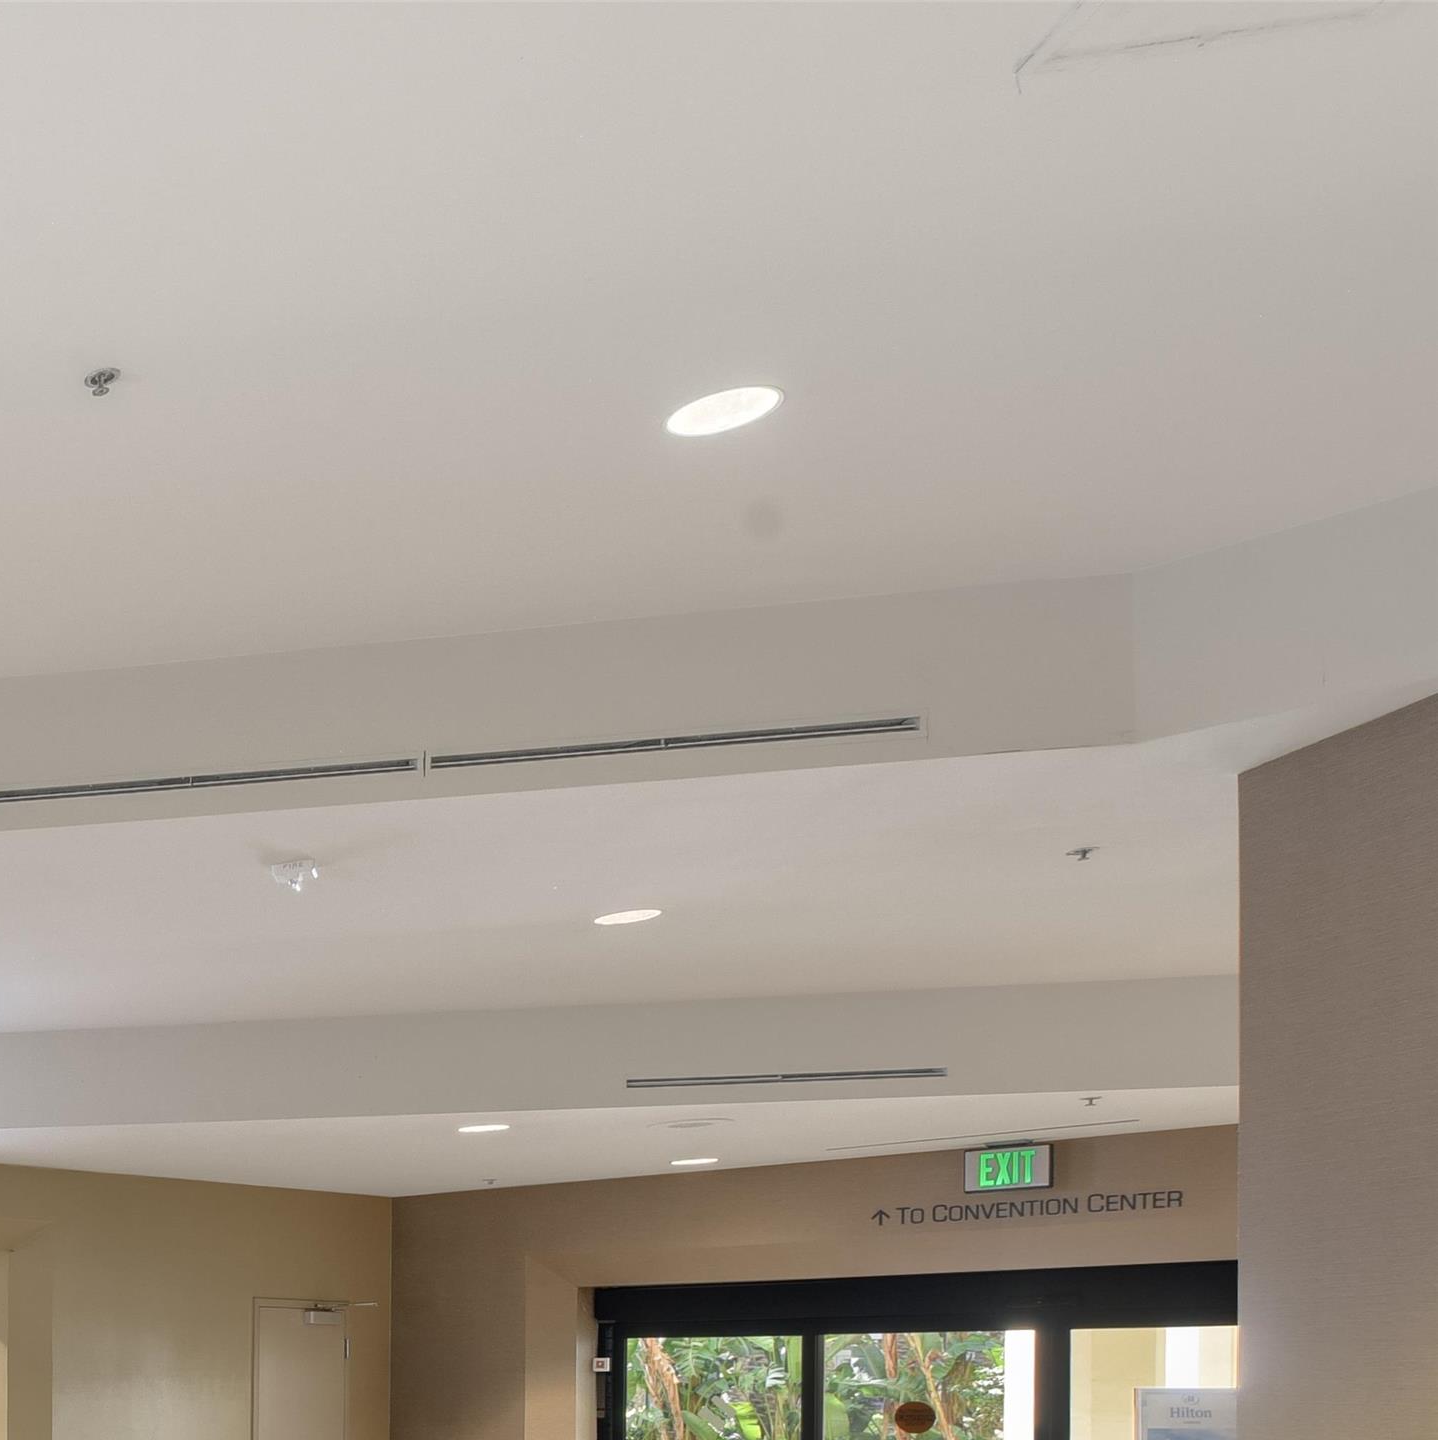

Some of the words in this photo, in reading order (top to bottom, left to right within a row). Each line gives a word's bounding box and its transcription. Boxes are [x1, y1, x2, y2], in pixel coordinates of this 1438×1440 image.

[979, 1149, 1036, 1188] EXIT
[932, 1197, 1079, 1223] CONVENTION
[1087, 1190, 1184, 1213] CENTER
[1169, 1407, 1212, 1418] Hilton
